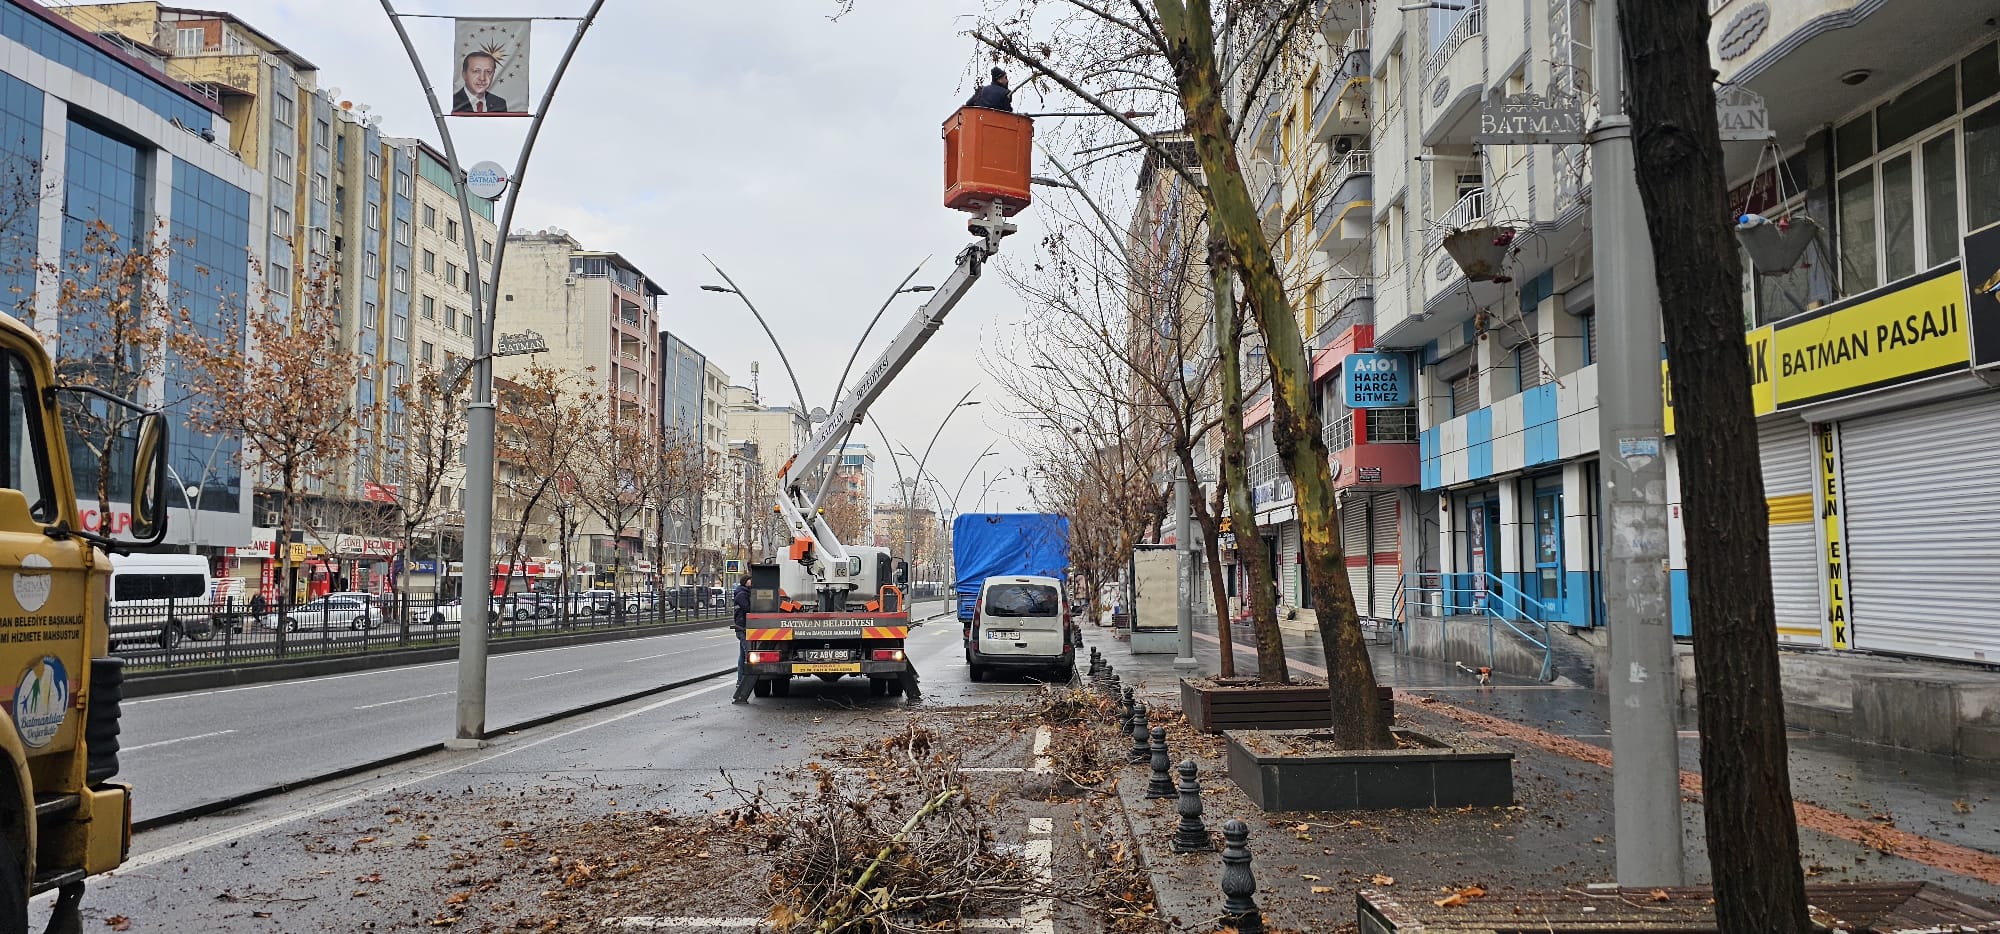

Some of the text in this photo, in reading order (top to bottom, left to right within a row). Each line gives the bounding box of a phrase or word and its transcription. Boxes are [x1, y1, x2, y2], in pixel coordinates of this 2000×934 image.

[1481, 113, 1580, 134] BATMAN
[1717, 108, 1765, 130] MAN
[469, 175, 499, 183] BATMAN
[499, 339, 545, 353] BATMAN
[1781, 302, 1958, 378] BATMAN PASAJI
[1354, 373, 1398, 382] HARCA
[1354, 383, 1398, 392] HARCA
[1830, 541, 1847, 644] EMLAK
[14, 615, 47, 627] BELEDİYE
[48, 613, 84, 627] BAŞKANLIĞI
[780, 618, 875, 628] BATMAN BELEDİYESİ
[11, 631, 42, 643] HİZMETE
[43, 629, 80, 641] MAHSUSTUR
